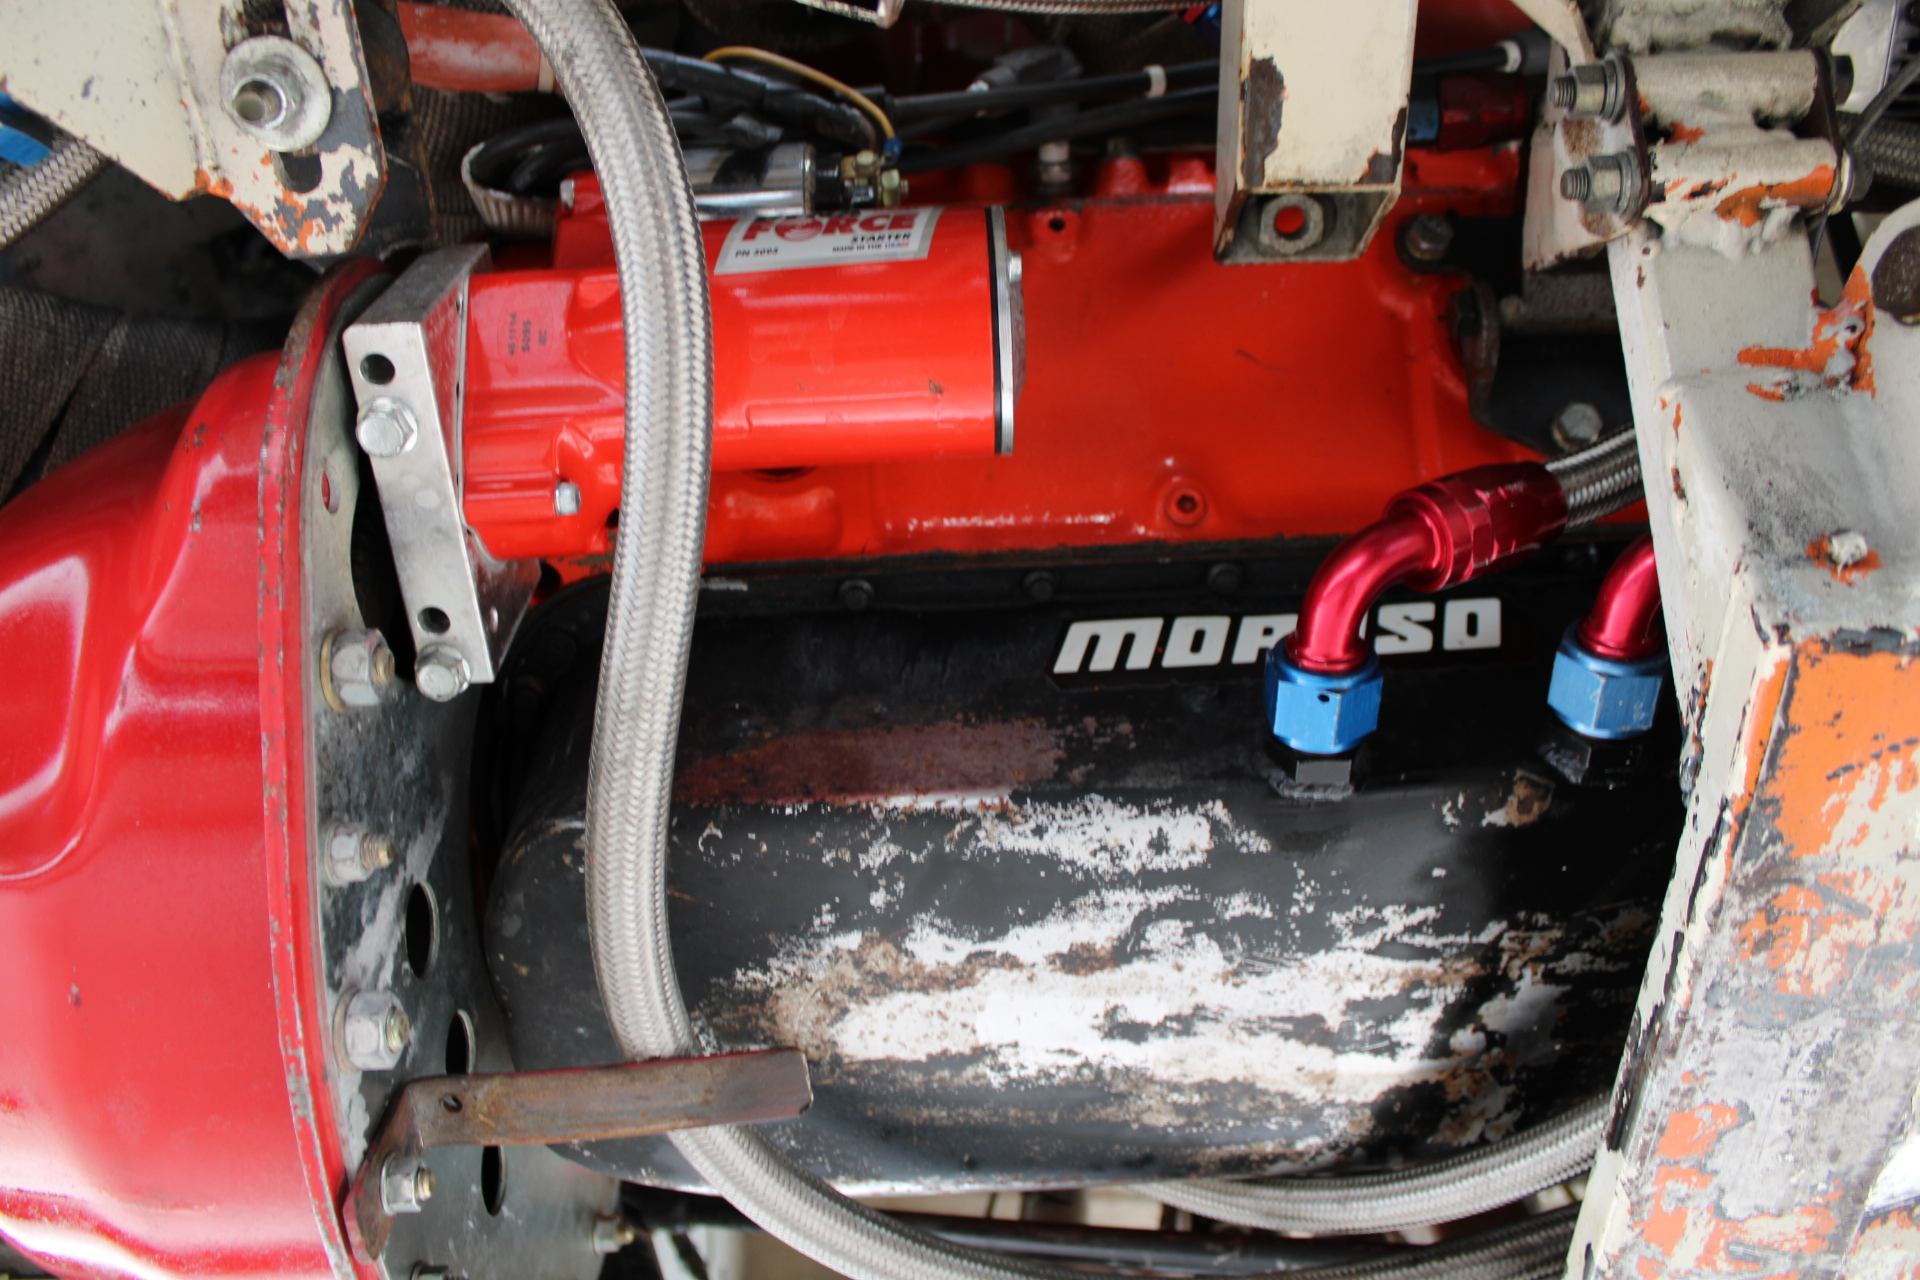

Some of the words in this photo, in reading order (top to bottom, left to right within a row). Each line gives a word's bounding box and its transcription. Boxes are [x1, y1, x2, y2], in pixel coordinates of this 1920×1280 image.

[742, 213, 916, 242] FORCE
[851, 230, 912, 243] STARTER
[832, 244, 854, 252] MADE
[867, 242, 882, 250] THE
[885, 241, 901, 249] USA
[735, 249, 750, 259] PN
[1053, 597, 1502, 674] MORSO
